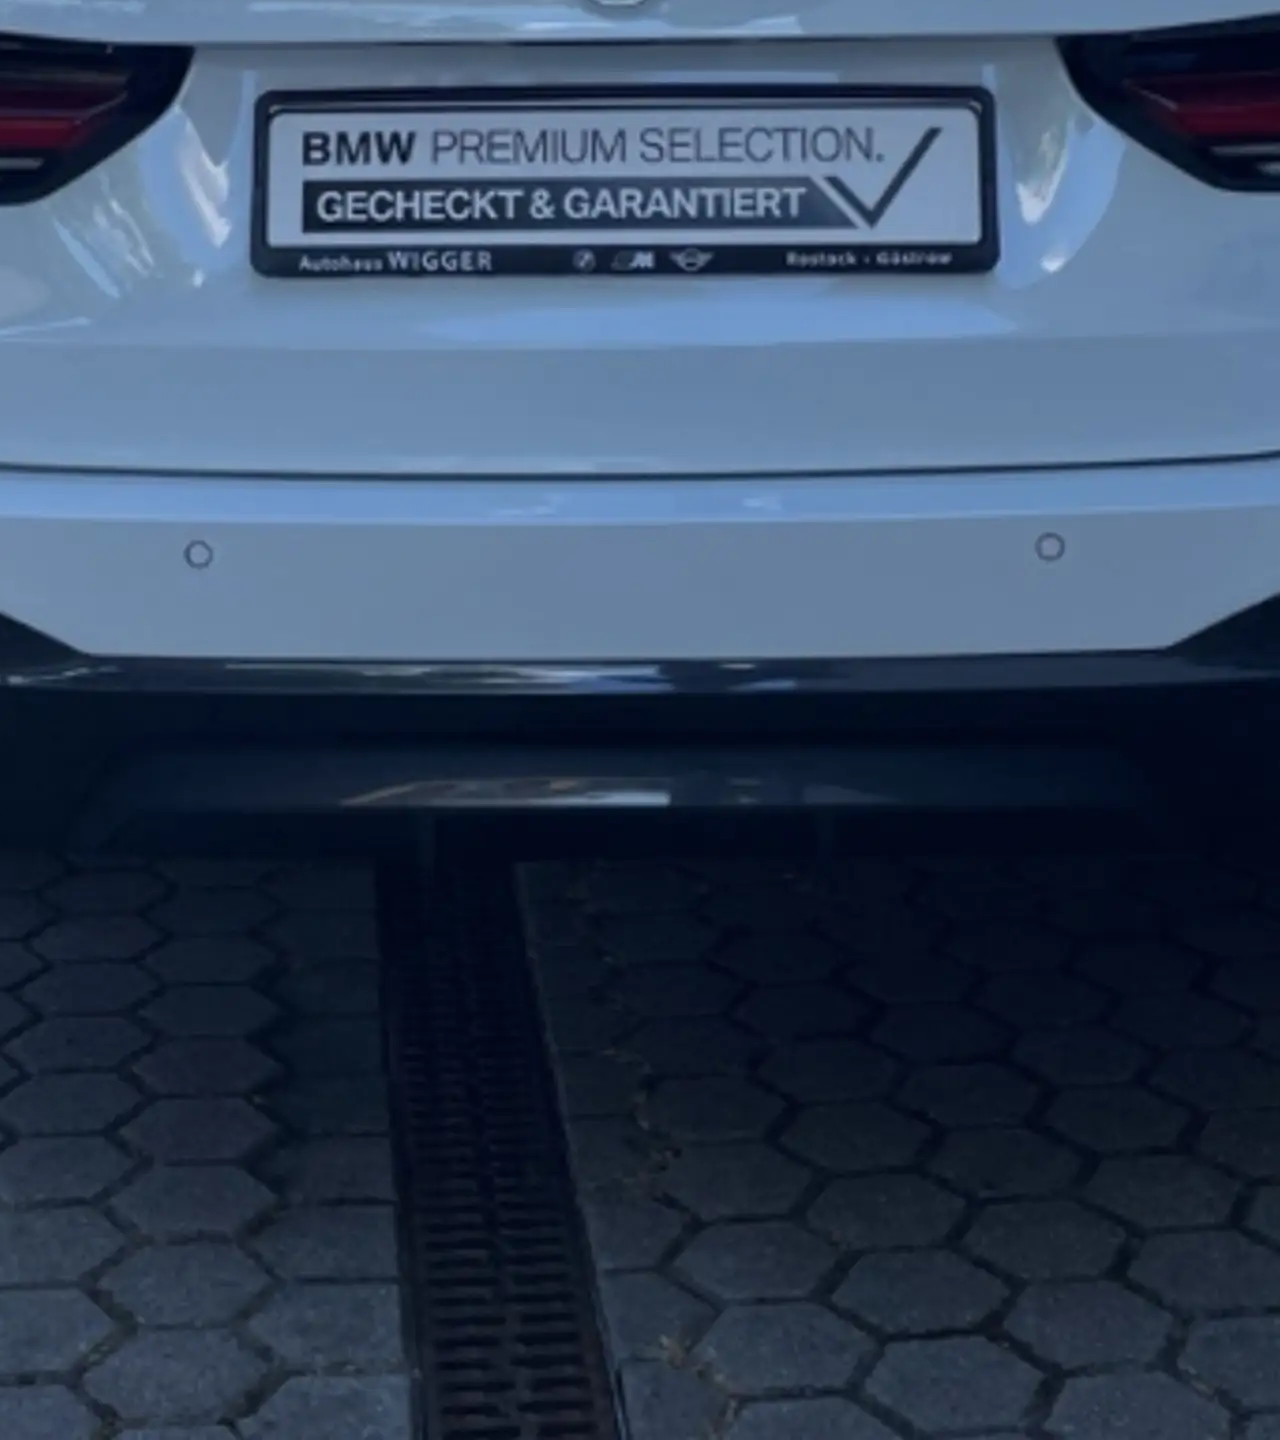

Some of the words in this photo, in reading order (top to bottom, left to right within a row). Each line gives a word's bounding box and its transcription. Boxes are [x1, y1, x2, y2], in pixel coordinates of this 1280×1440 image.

[302, 130, 417, 167] BMW
[431, 127, 627, 165] PREMIUM
[638, 126, 886, 164] SELECTION.
[316, 189, 525, 223] GECHECKT
[528, 187, 556, 221] &
[563, 185, 808, 221] GARANTIERT
[298, 254, 385, 273] Autohaus
[386, 250, 494, 273] WIGGER
